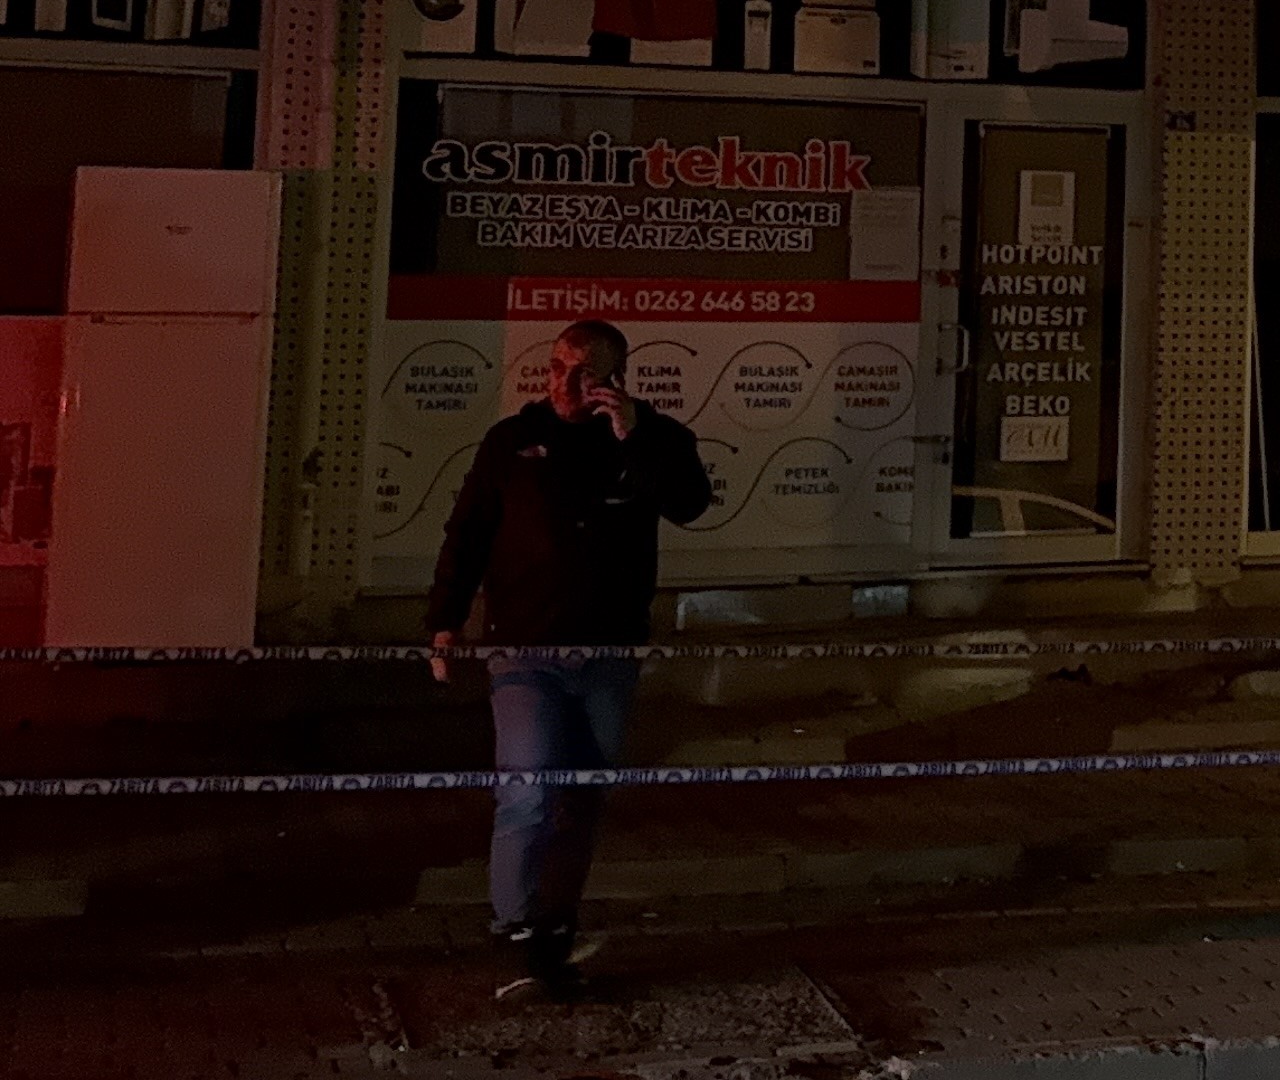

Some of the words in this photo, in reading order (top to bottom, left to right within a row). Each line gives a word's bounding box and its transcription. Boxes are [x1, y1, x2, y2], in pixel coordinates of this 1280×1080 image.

[423, 132, 872, 191] asmirteknik
[447, 192, 543, 218] BEYAZ
[545, 195, 621, 222] EŞYA
[477, 220, 573, 247] BAKIM
[577, 223, 617, 248] VE
[618, 224, 703, 249] ARIZA
[982, 244, 1103, 265] HOTPOINT
[980, 275, 1086, 295] ARISTON
[508, 283, 628, 314] İLETİŞİM:
[634, 290, 695, 311] 0262
[700, 290, 745, 311] 646
[750, 290, 780, 311] 58
[785, 291, 815, 312] 23
[991, 305, 1088, 326] INDESIT
[994, 331, 1085, 351] VESTEL
[739, 366, 799, 378] BULAŞIK
[987, 357, 1091, 387] ARÇELİK
[1006, 395, 1070, 415] BEKO
